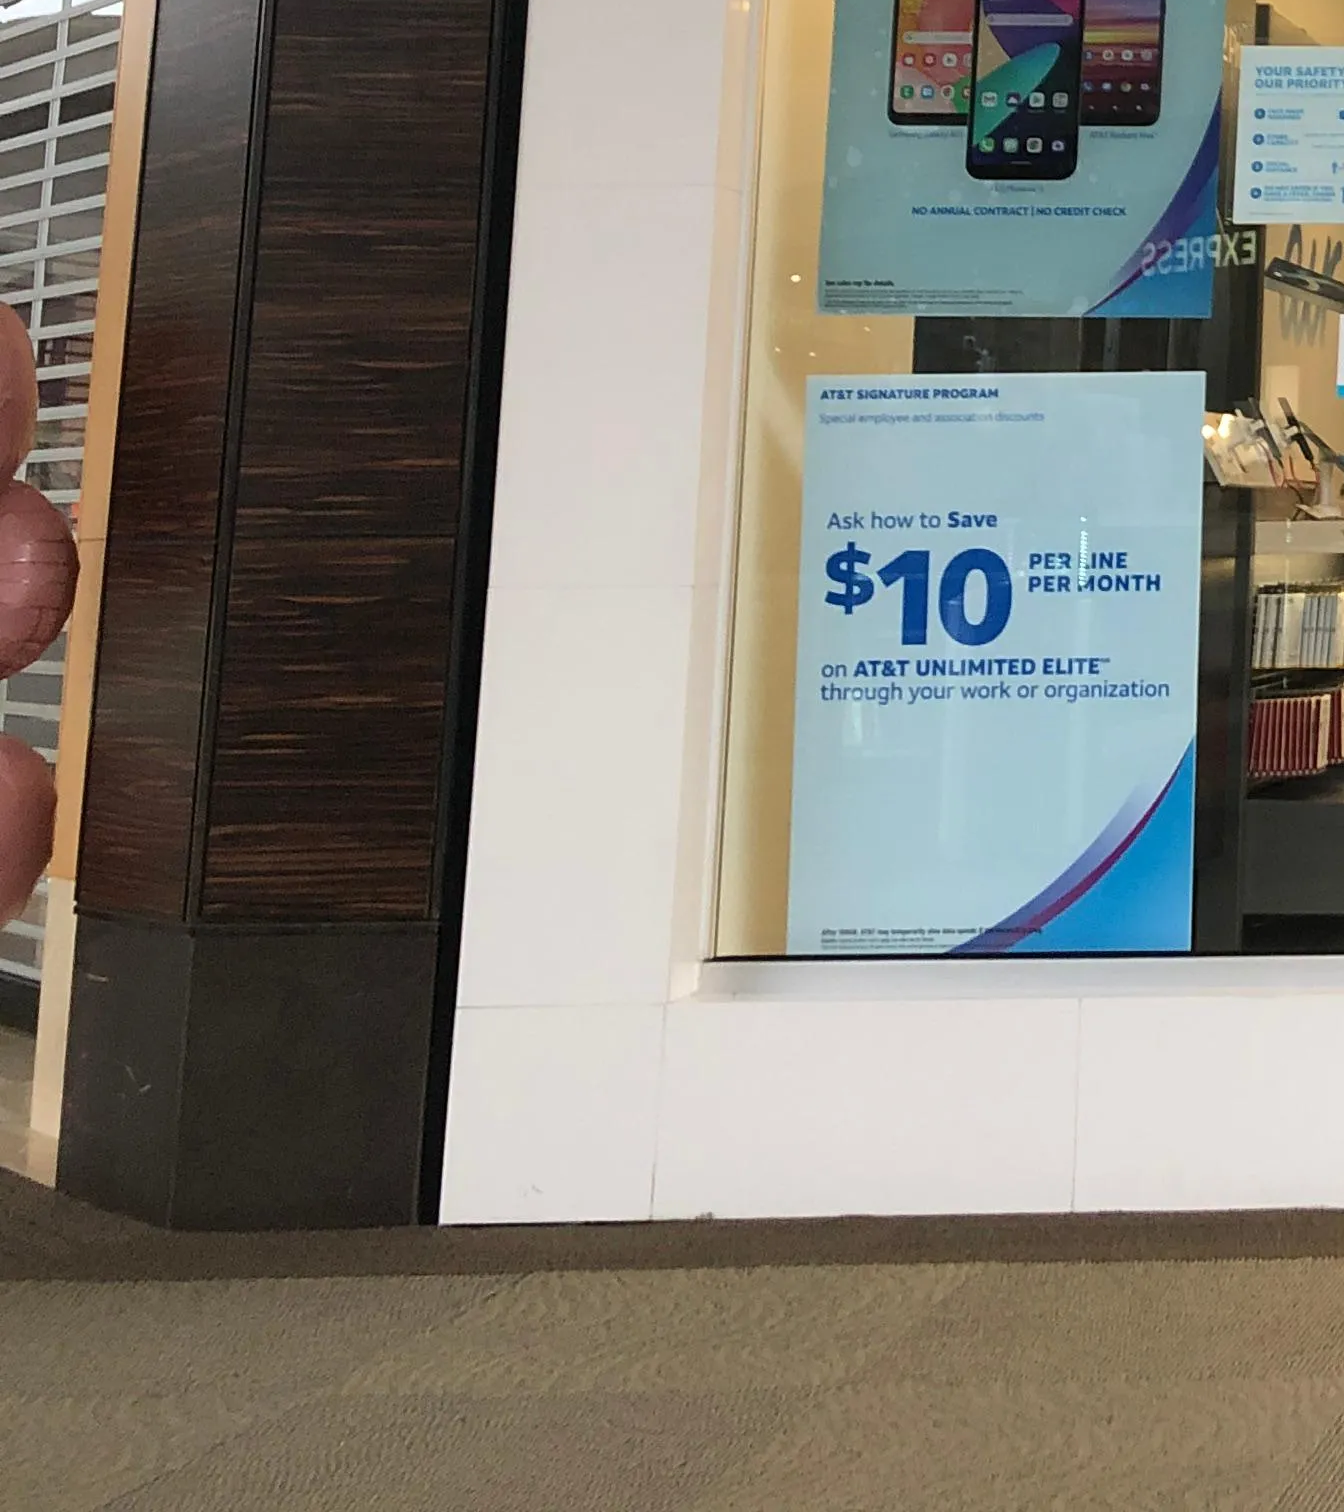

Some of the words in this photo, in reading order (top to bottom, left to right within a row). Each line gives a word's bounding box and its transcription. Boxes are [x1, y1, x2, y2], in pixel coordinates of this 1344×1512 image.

[1256, 66, 1292, 76] YOUR
[1255, 78, 1283, 88] OUR
[912, 206, 927, 216] NO
[929, 206, 971, 216] ANNUAL
[973, 207, 1029, 216] CONTRACT
[1036, 207, 1051, 216] NO
[1054, 207, 1089, 216] CREDIT
[1092, 207, 1126, 216] CHECK
[820, 389, 853, 400] AT&T
[857, 389, 929, 400] SIGNATURE
[933, 388, 999, 399] PROGRAM
[819, 413, 856, 425] Special
[859, 413, 910, 425] employee
[912, 412, 932, 423] and
[995, 411, 1044, 422] discounts
[827, 512, 864, 529] Ask
[871, 512, 912, 529] how
[920, 514, 941, 529] to
[948, 512, 998, 529] Save
[1029, 553, 1071, 569] PER
[1029, 576, 1070, 593] PER
[1078, 574, 1161, 592] MONTH
[824, 541, 1013, 646] $10
[821, 664, 847, 678] on
[853, 660, 910, 678] AT&T
[916, 658, 1035, 676] UNLIMITED
[821, 684, 902, 705] through
[907, 685, 954, 704] your
[961, 681, 1010, 699] work
[1016, 684, 1038, 698] or
[1044, 680, 1170, 703] organization
